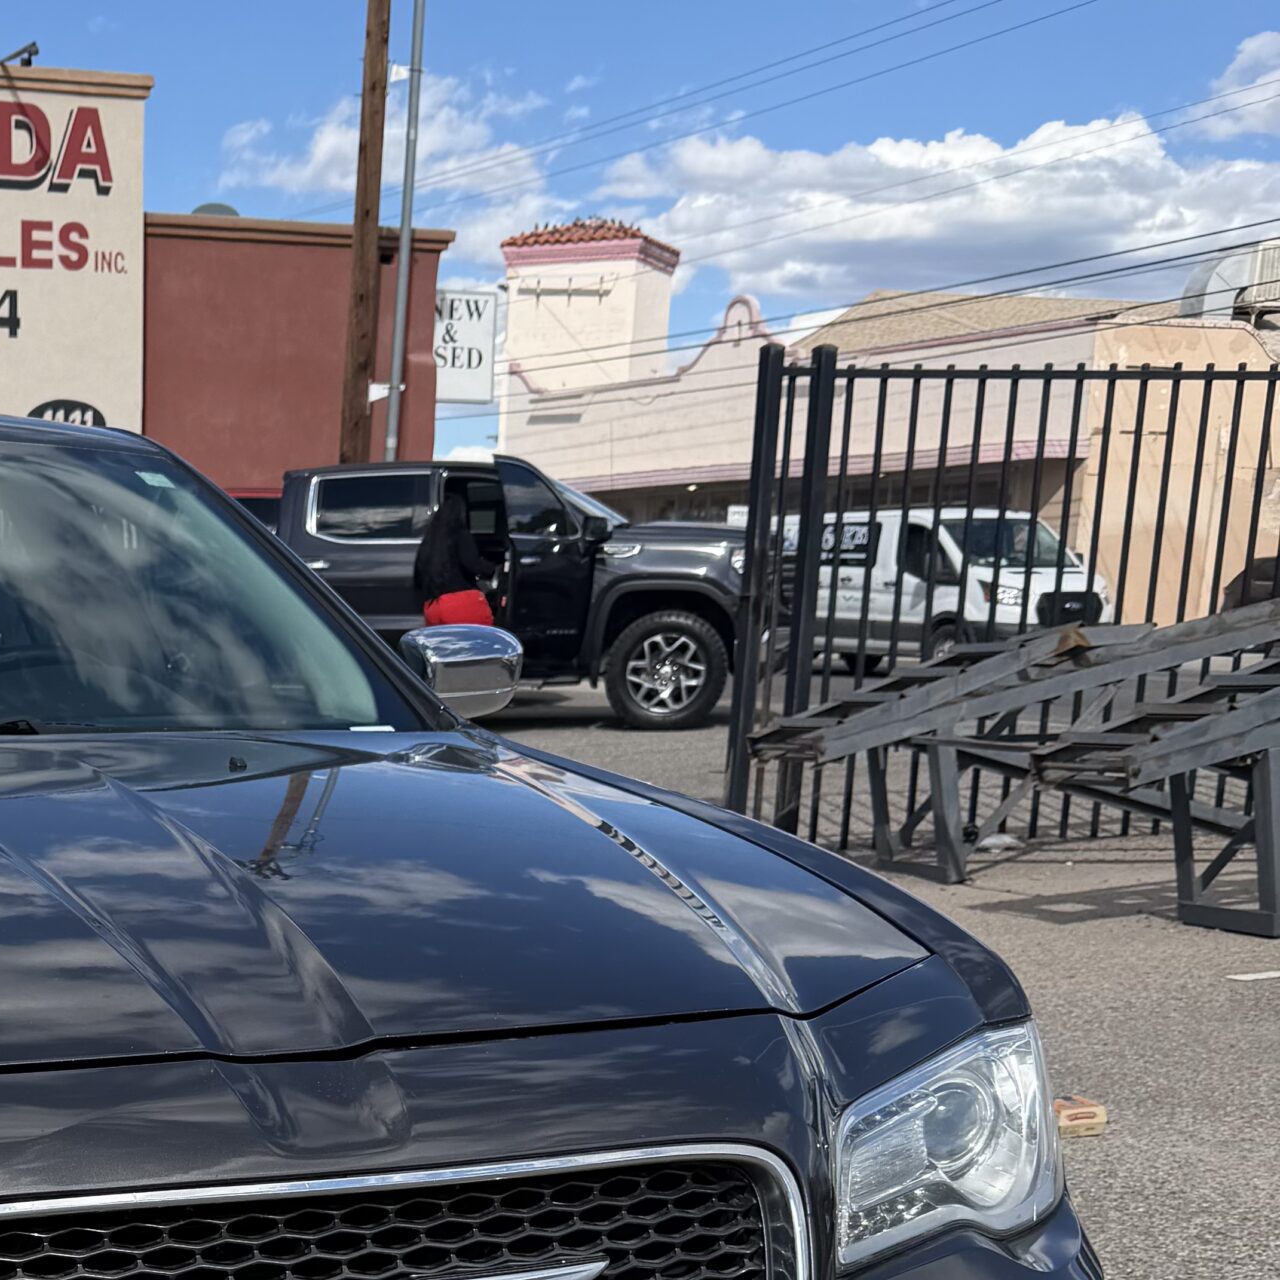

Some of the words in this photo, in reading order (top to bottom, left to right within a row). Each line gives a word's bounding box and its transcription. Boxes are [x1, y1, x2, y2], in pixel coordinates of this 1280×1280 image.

[93, 250, 128, 275] INC.
[442, 321, 458, 345] &
[434, 345, 483, 370] SED
